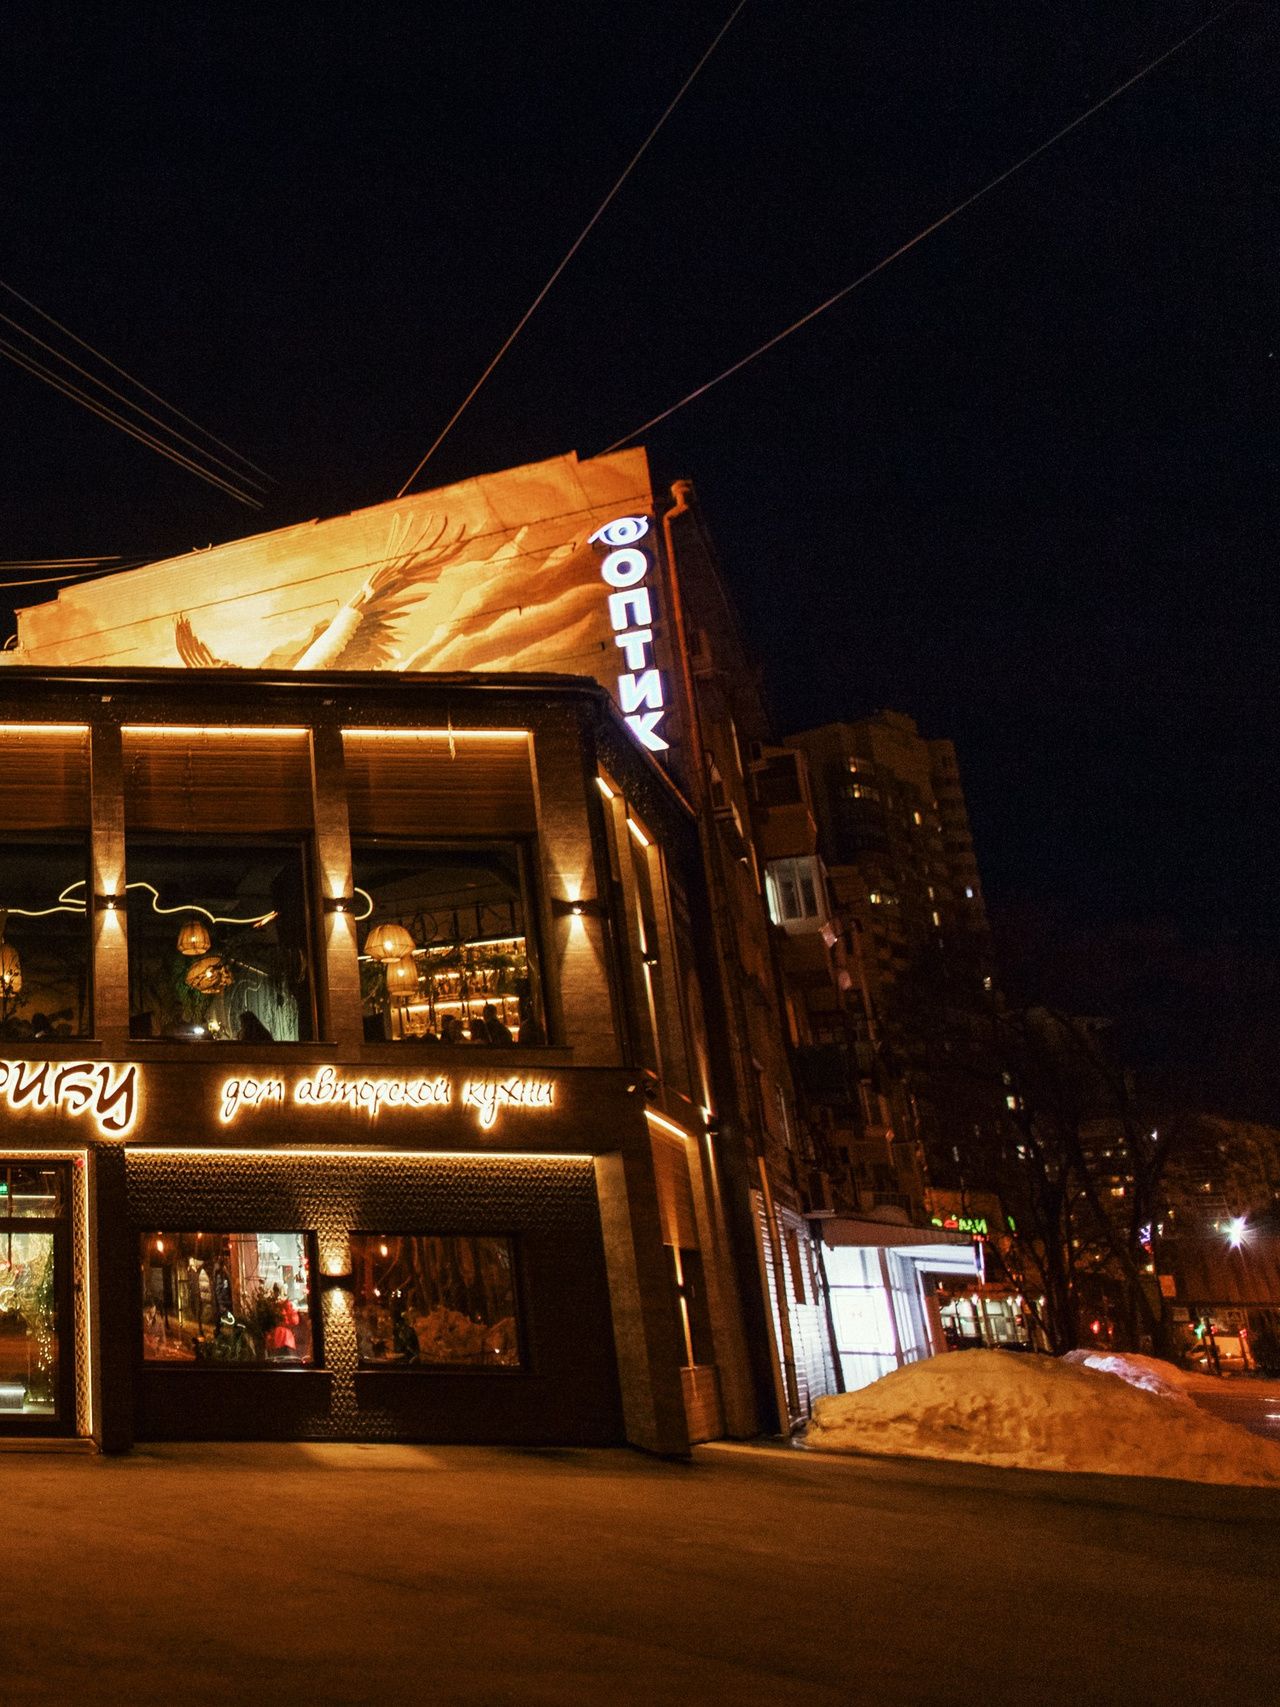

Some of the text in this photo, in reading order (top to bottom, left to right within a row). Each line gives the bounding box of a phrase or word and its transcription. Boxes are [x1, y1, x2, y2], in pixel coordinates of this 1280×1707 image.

[223, 1067, 554, 1126] дом авторской кухни
